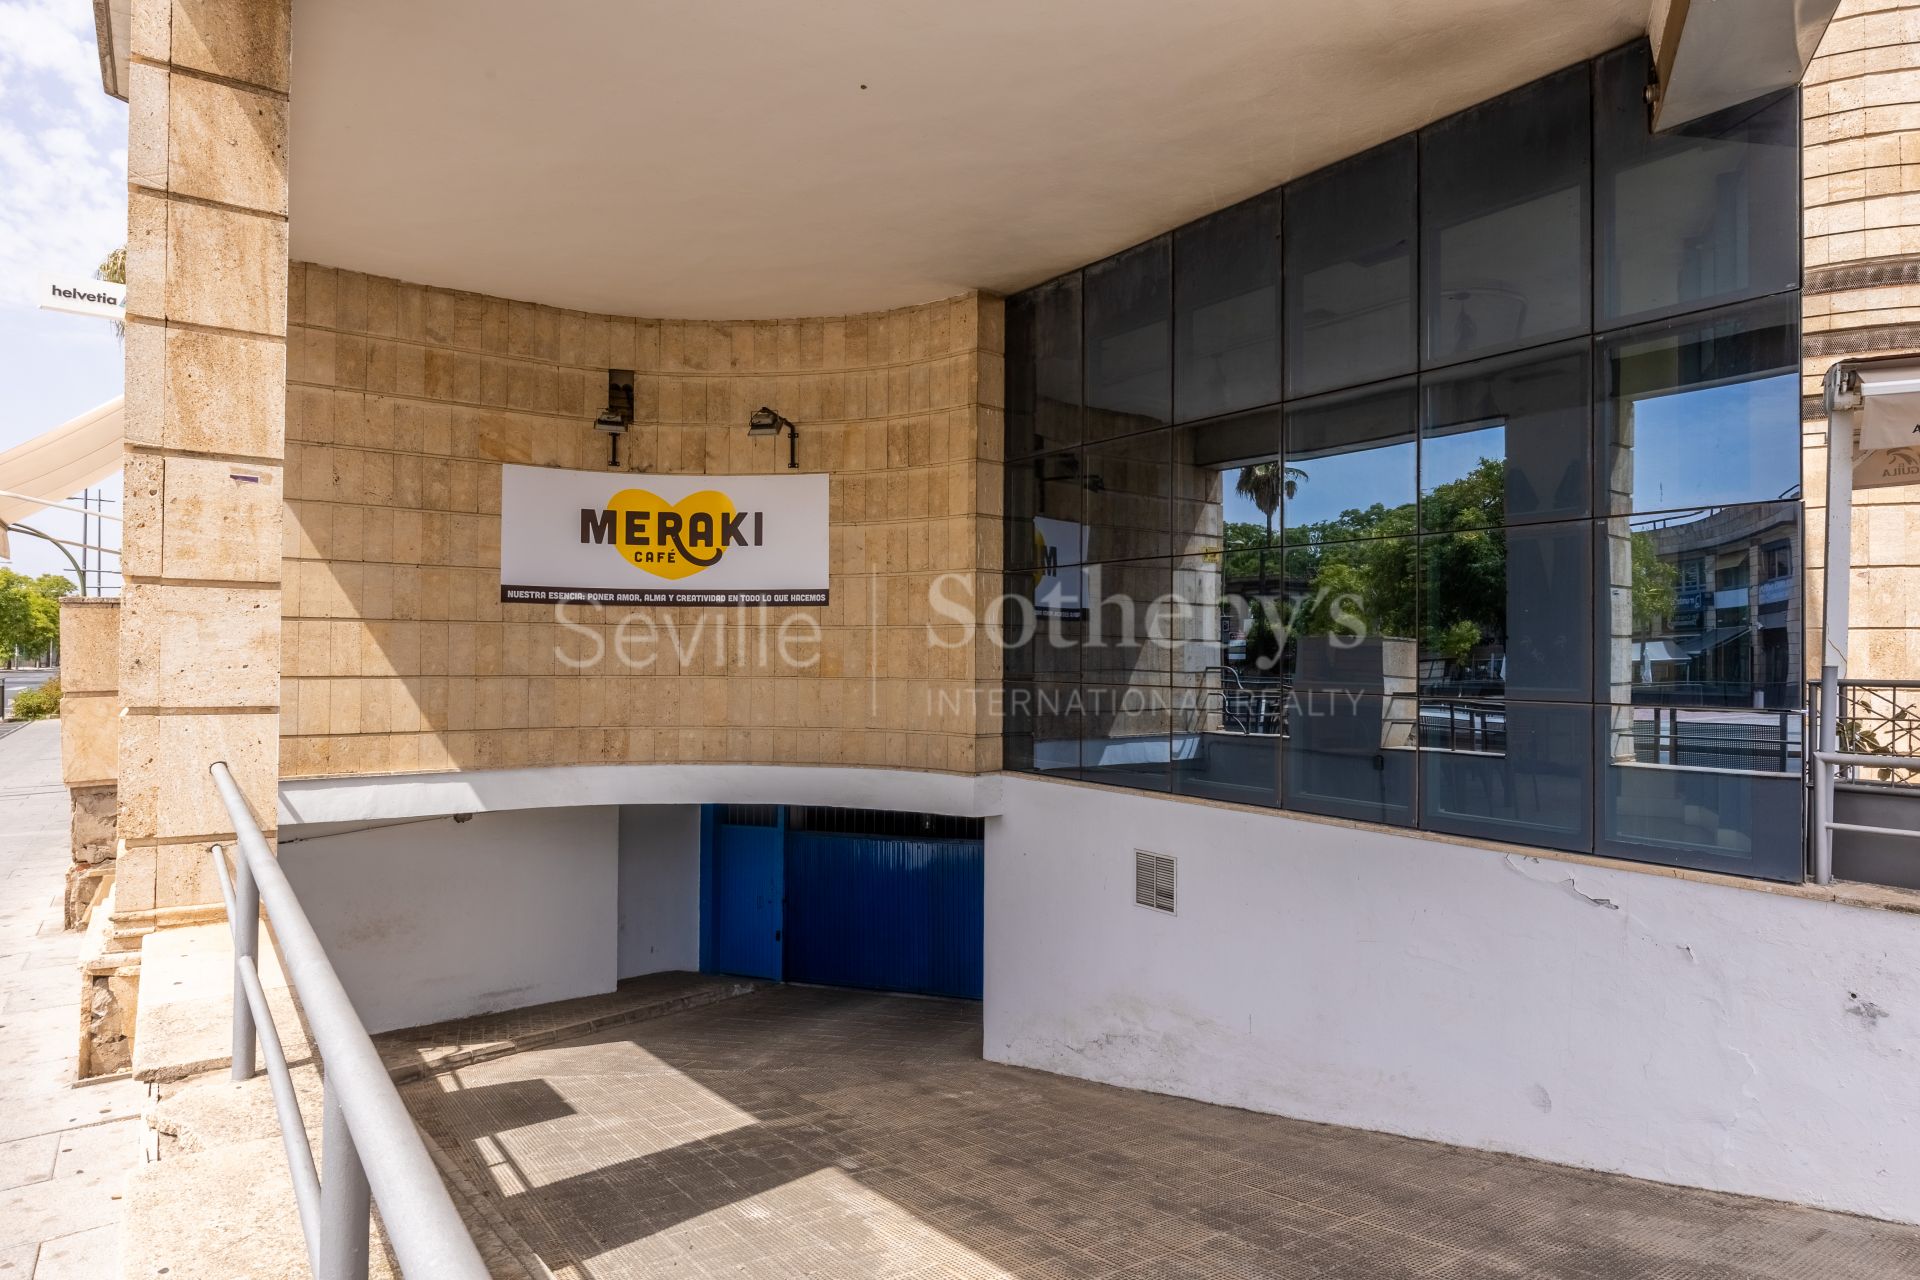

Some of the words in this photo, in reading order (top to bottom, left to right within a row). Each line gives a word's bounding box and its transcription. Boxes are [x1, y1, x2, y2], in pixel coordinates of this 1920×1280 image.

[52, 284, 117, 306] helvetia
[580, 508, 763, 567] MERAKI
[634, 549, 676, 563] CAFÉ
[507, 590, 546, 599] NUESTRA
[548, 591, 586, 600] ESENCIA:
[587, 593, 616, 602] PONER
[616, 594, 642, 603] AMOR,
[644, 594, 667, 602] ALMA
[668, 594, 675, 602] Y
[676, 594, 726, 602] CREATIVIDAD
[728, 594, 739, 602] EN
[740, 594, 760, 602] TODO
[762, 594, 772, 602] LO
[773, 594, 789, 602] QUE
[790, 593, 826, 602] HACEMOS
